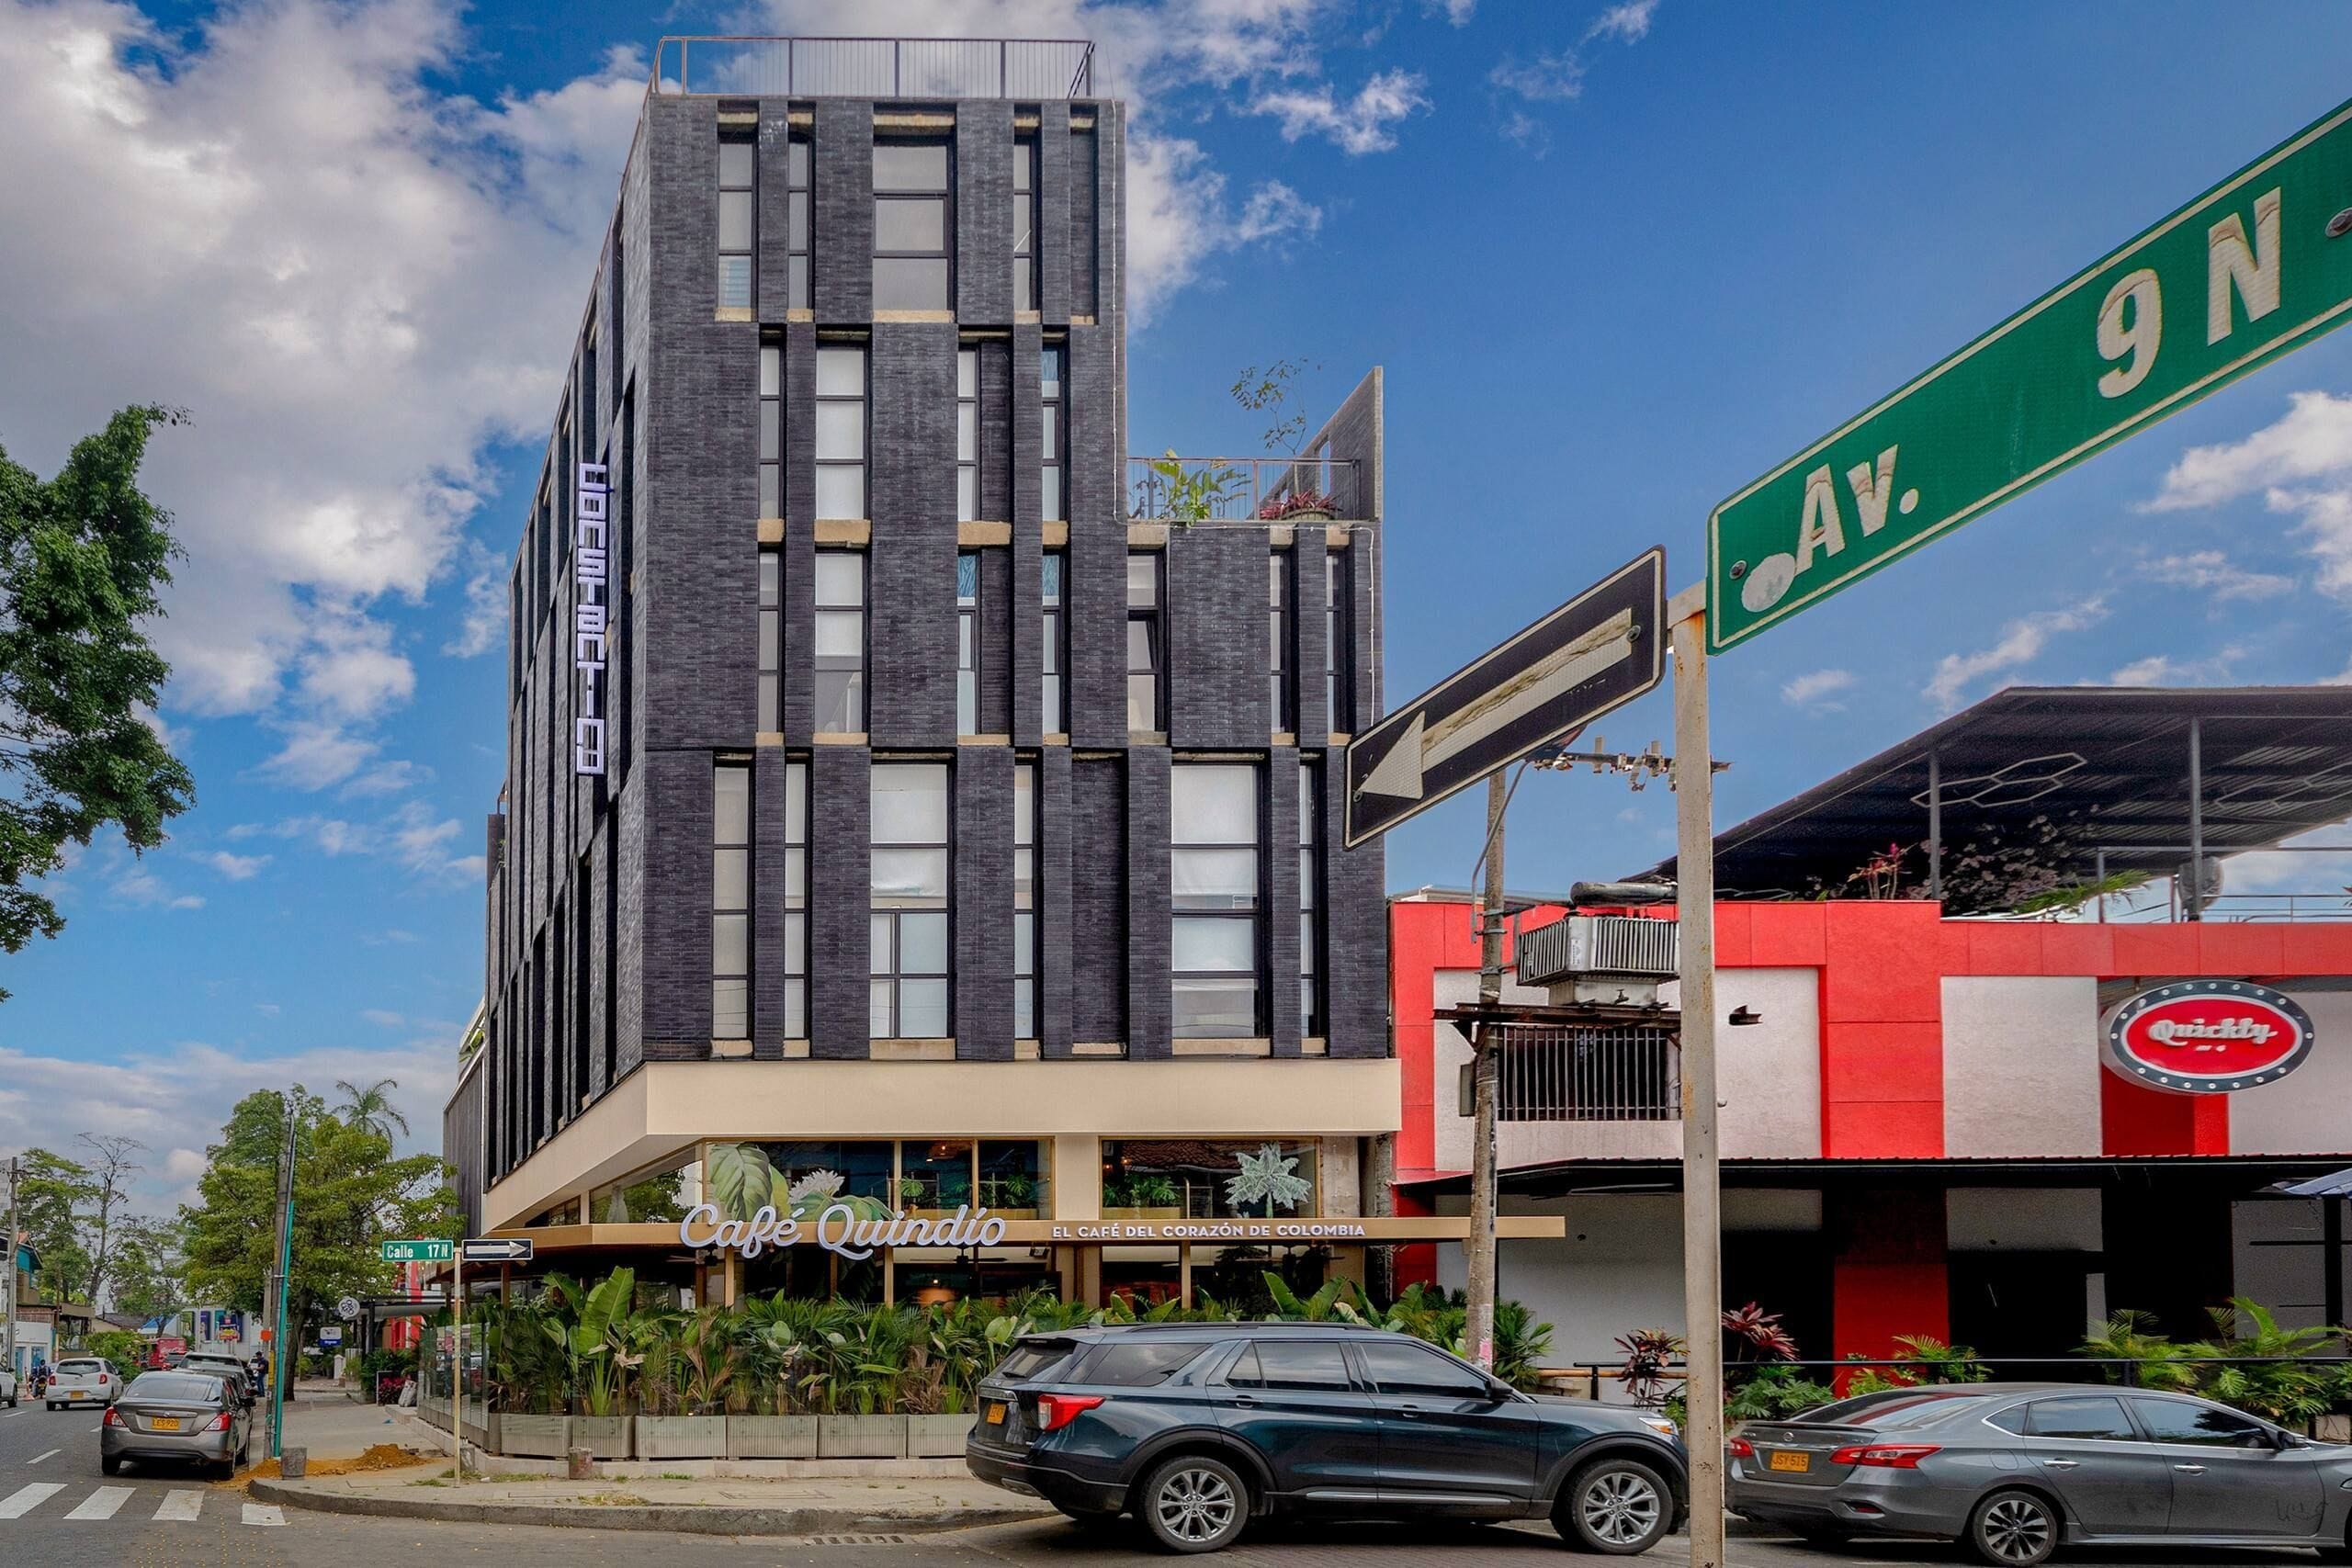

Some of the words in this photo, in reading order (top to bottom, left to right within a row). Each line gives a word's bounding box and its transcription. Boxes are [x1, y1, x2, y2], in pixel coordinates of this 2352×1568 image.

[1794, 445, 1920, 576] Av.
[2096, 267, 2163, 400] 9
[2207, 186, 2282, 347] N
[2149, 1017, 2278, 1046] Quickly
[680, 1204, 806, 1259] Café
[818, 1204, 1006, 1261] Quindío
[1052, 1226, 1072, 1238] EL
[1078, 1223, 1120, 1238] CAFÉ
[1125, 1225, 1157, 1237] DEL
[1162, 1223, 1244, 1237] CORAZÓN
[1250, 1225, 1271, 1236] DE
[1275, 1224, 1366, 1236] COLOMBIA
[387, 1245, 413, 1258] Calle
